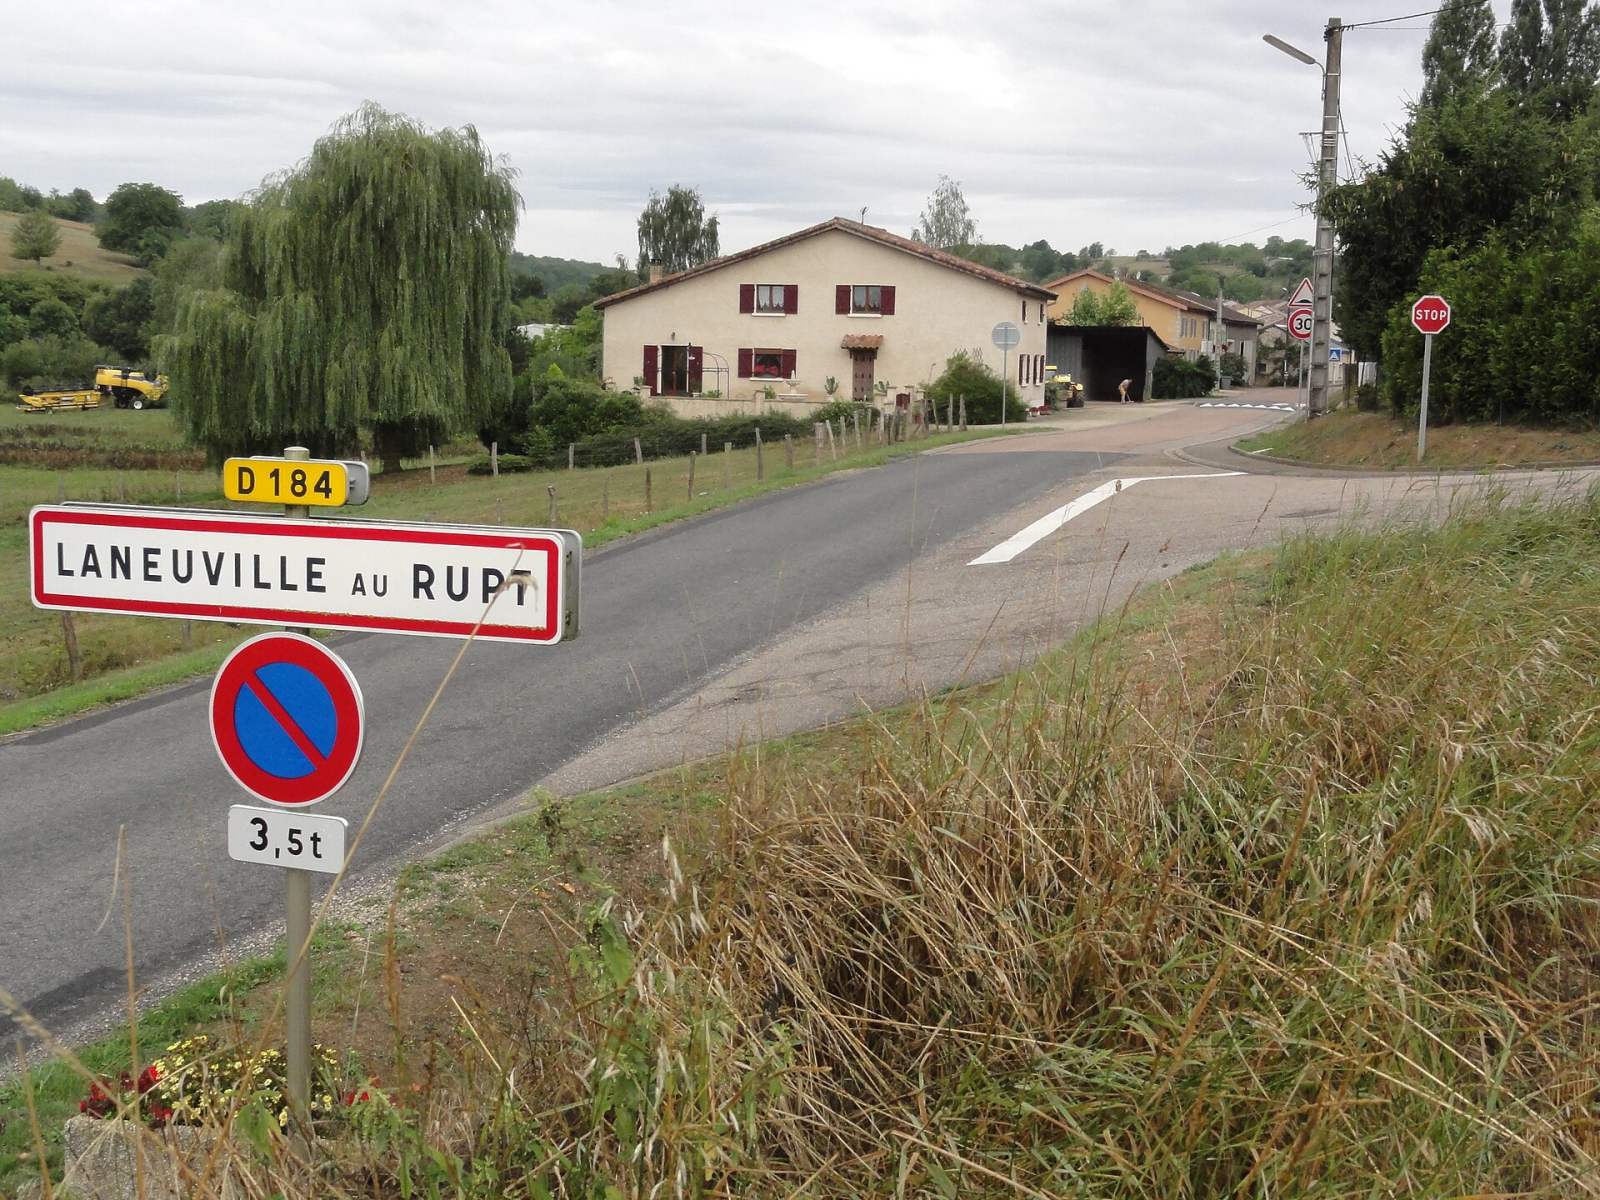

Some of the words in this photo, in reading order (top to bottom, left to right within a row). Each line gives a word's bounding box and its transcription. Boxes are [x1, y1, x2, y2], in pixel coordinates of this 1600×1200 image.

[1294, 318, 1312, 330] 30
[1416, 309, 1447, 320] STOP
[238, 466, 255, 494] D
[269, 468, 332, 499] 184
[57, 542, 326, 593] LANEUVILLE
[351, 573, 388, 597] AU
[413, 563, 531, 606] RUPT
[249, 817, 322, 859] 3,5t
